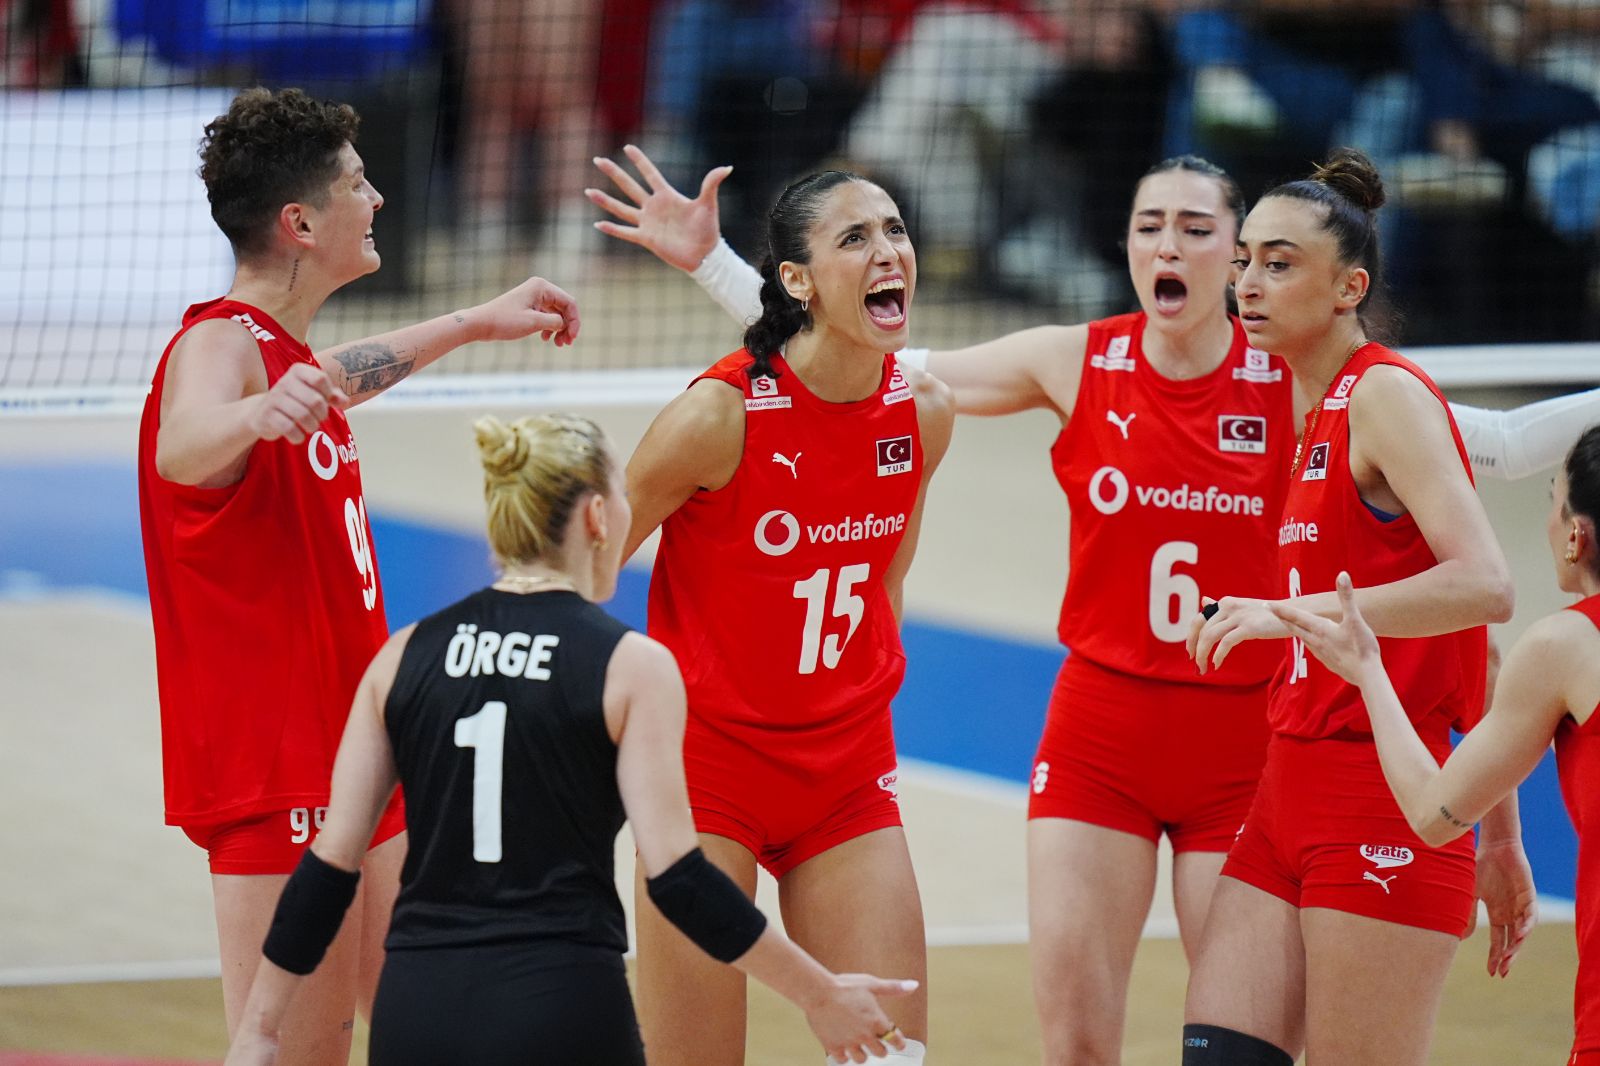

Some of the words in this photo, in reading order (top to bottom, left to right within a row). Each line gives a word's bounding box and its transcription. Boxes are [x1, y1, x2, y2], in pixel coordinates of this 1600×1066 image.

[757, 378, 771, 391] S
[893, 369, 903, 383] S
[1340, 380, 1350, 391] S
[886, 464, 905, 473] TUR
[1306, 470, 1320, 478] TUR
[1135, 484, 1264, 516] vodafone
[807, 513, 905, 544] vodafone
[1149, 540, 1200, 643] 6
[792, 562, 870, 675] 15
[445, 623, 560, 681] ÖRGE
[454, 701, 507, 863] 1
[1365, 845, 1409, 860] gratis
